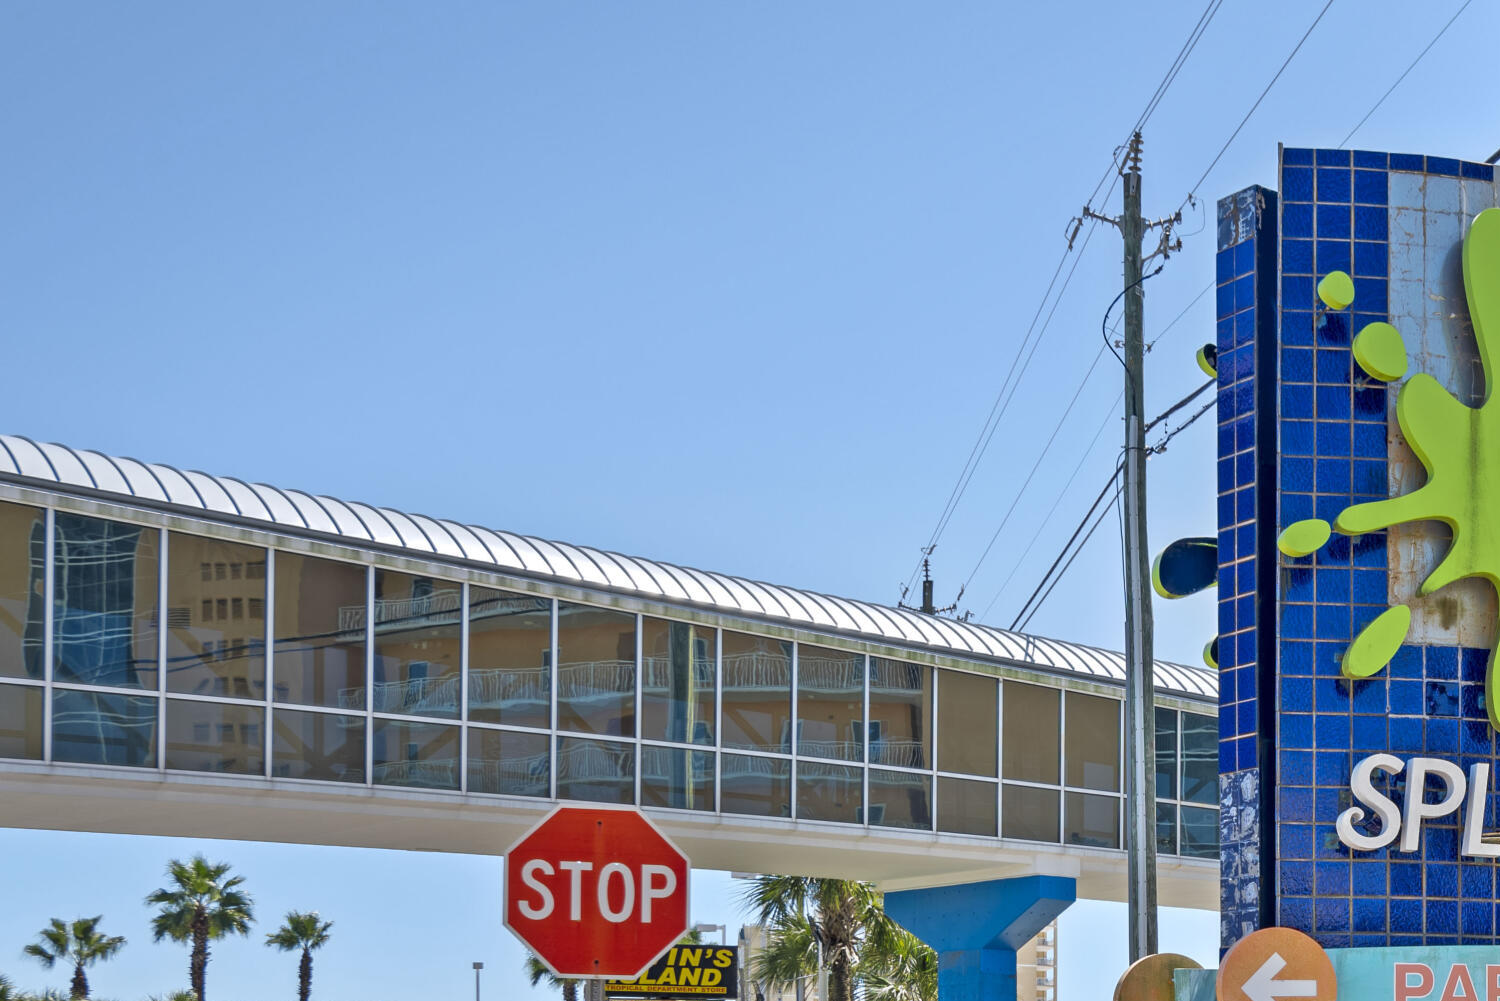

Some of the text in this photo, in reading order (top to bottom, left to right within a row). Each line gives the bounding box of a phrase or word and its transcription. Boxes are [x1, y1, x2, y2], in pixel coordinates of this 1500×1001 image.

[518, 859, 677, 923] STOP
[654, 948, 734, 968] IN'S
[608, 967, 722, 986] LAND
